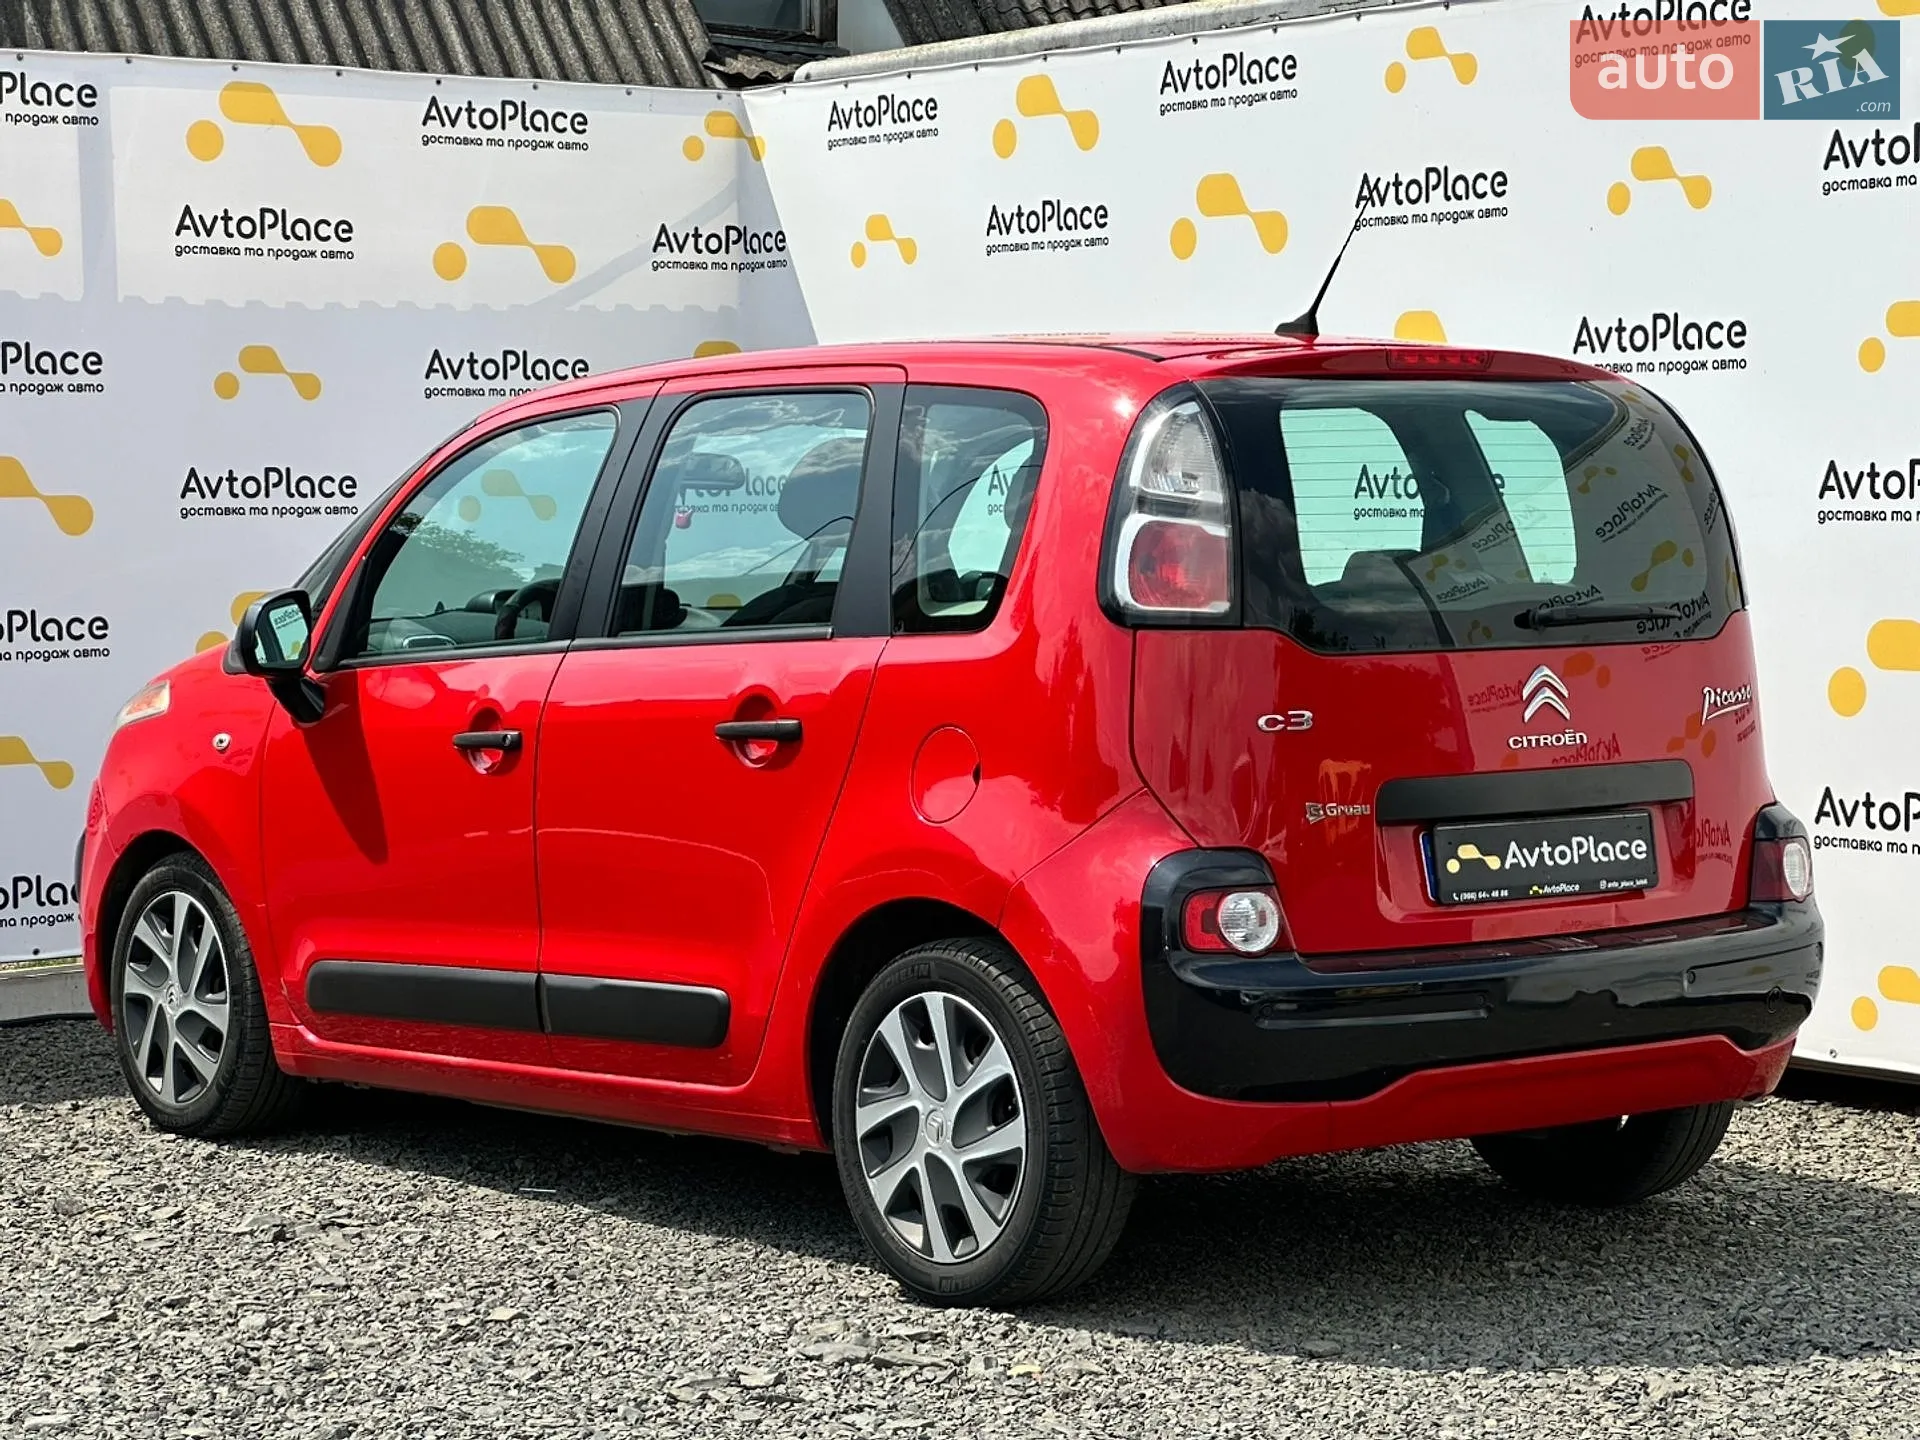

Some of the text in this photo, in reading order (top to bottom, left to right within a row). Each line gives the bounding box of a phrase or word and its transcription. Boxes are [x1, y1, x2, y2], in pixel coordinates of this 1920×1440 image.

[1716, 34, 1751, 48] авто
[1160, 51, 1297, 95] AvtoPlace
[1160, 88, 1298, 116] доставка та продаж авто
[5, 113, 99, 127] продаж авто
[422, 95, 589, 135] AvtoPlace
[827, 93, 938, 132] AvtoPlace
[421, 134, 589, 152] доставка та продаж авто
[1355, 165, 1508, 209] AvtoPlace
[1822, 174, 1917, 196] доставка та
[175, 204, 354, 243] AvtoPlace
[986, 199, 1109, 236] AvtoPlace
[1411, 213, 1428, 224] та
[1431, 208, 1475, 225] продаж
[1478, 206, 1508, 219] авто
[652, 223, 787, 255] AvtoPlace
[175, 245, 354, 261] доставка та продаж авто
[651, 260, 708, 271] доставка
[711, 261, 728, 271] та
[1573, 312, 1747, 354] AvtoPlace
[424, 348, 590, 382] AvtoPlace
[1636, 361, 1655, 373] та
[1658, 360, 1708, 375] продаж
[1712, 358, 1747, 370] авто
[10, 382, 64, 396] продаж
[67, 383, 105, 393] авто
[424, 386, 486, 399] доставка
[488, 387, 507, 397] та
[180, 467, 358, 499] AvtoPlace
[180, 505, 359, 519] доставка та продаж авто
[1817, 509, 1887, 525] доставка
[1891, 510, 1912, 521] та
[16, 649, 70, 663] продаж
[73, 647, 110, 658] авто
[1257, 710, 1313, 731] C3
[1325, 803, 1371, 816] Gruau
[1504, 835, 1648, 869] AvtoPlace
[1813, 835, 1883, 851] доставка
[1887, 841, 1908, 854] та
[1543, 882, 1580, 894] AvtoPlace
[21, 912, 75, 928] продаж
